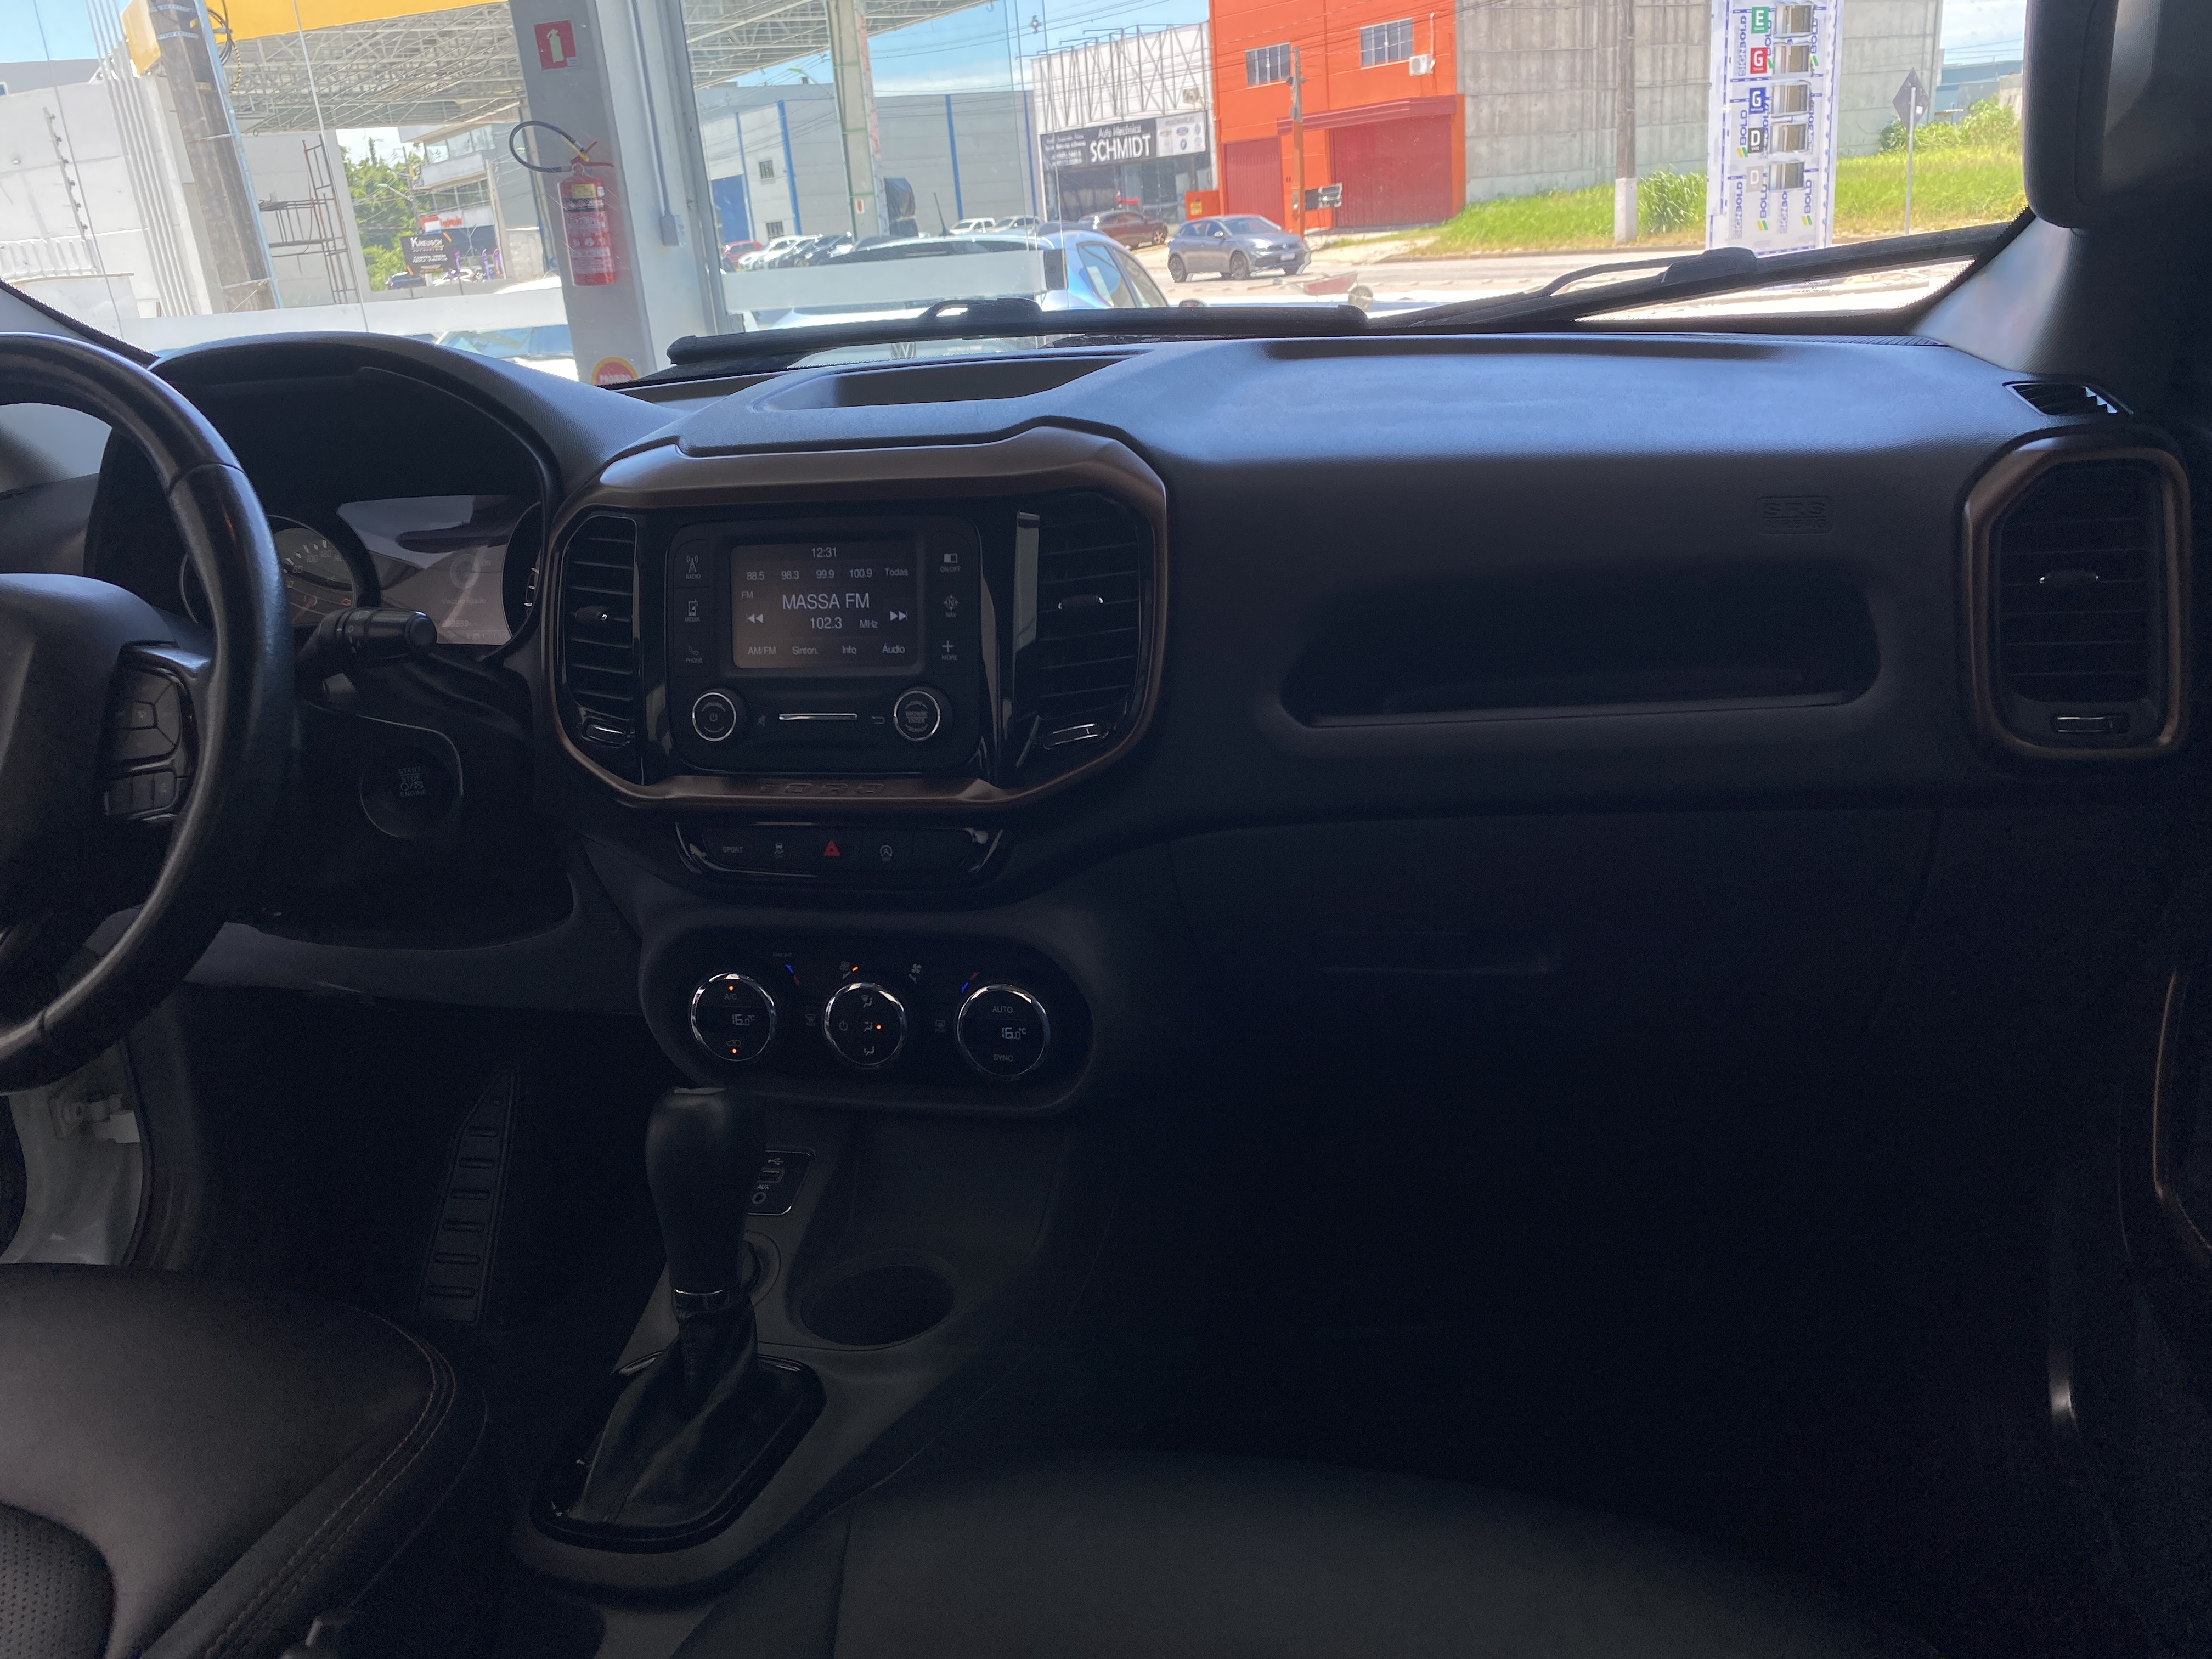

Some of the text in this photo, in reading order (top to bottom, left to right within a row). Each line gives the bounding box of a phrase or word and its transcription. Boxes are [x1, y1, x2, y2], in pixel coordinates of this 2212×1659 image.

[1756, 10, 1764, 26] E
[1753, 50, 1763, 67] G
[1752, 90, 1761, 107] G
[1751, 129, 1761, 147] D
[1090, 133, 1152, 163] SCHMIDT
[1750, 169, 1759, 185] D
[1804, 179, 1812, 214] BOLD
[1763, 501, 1826, 515] SRS
[307, 555, 319, 563] 100
[811, 547, 837, 558] 12:31
[747, 567, 909, 580] 88.5 98.3 99.9 100.9 Todas
[782, 592, 870, 610] MASSA FM
[809, 616, 878, 629] 102.3 MHz
[748, 642, 906, 656] AM/FM Sinton. Info Áudio
[992, 1006, 1013, 1014] AUTO
[993, 1053, 1014, 1062] SYNC
